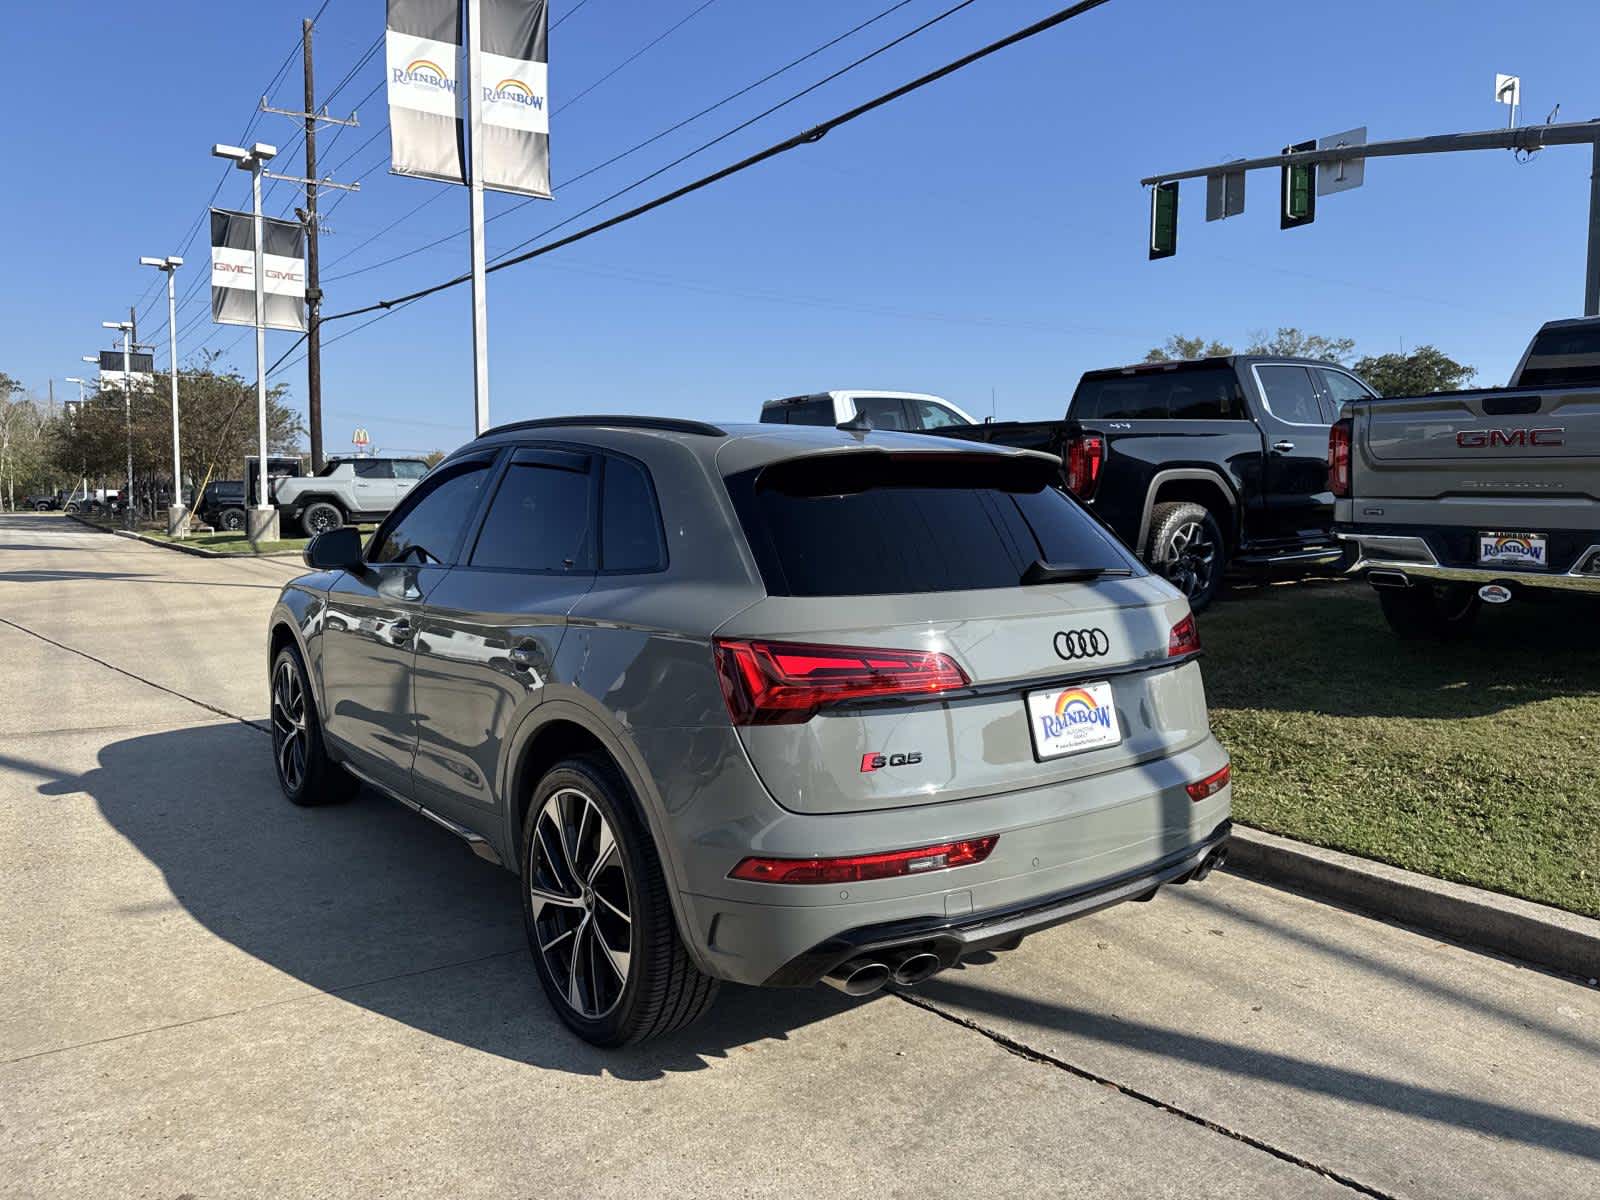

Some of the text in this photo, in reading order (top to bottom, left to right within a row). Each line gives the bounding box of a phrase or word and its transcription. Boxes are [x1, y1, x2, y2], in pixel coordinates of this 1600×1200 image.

[392, 67, 458, 94] RAINBOW
[482, 87, 544, 110] RAINBOW
[214, 262, 253, 274] GMC
[265, 269, 304, 282] GMC
[1456, 428, 1566, 448] GMC
[1483, 543, 1543, 560] RAINBOW
[1040, 705, 1110, 741] RAINBOW
